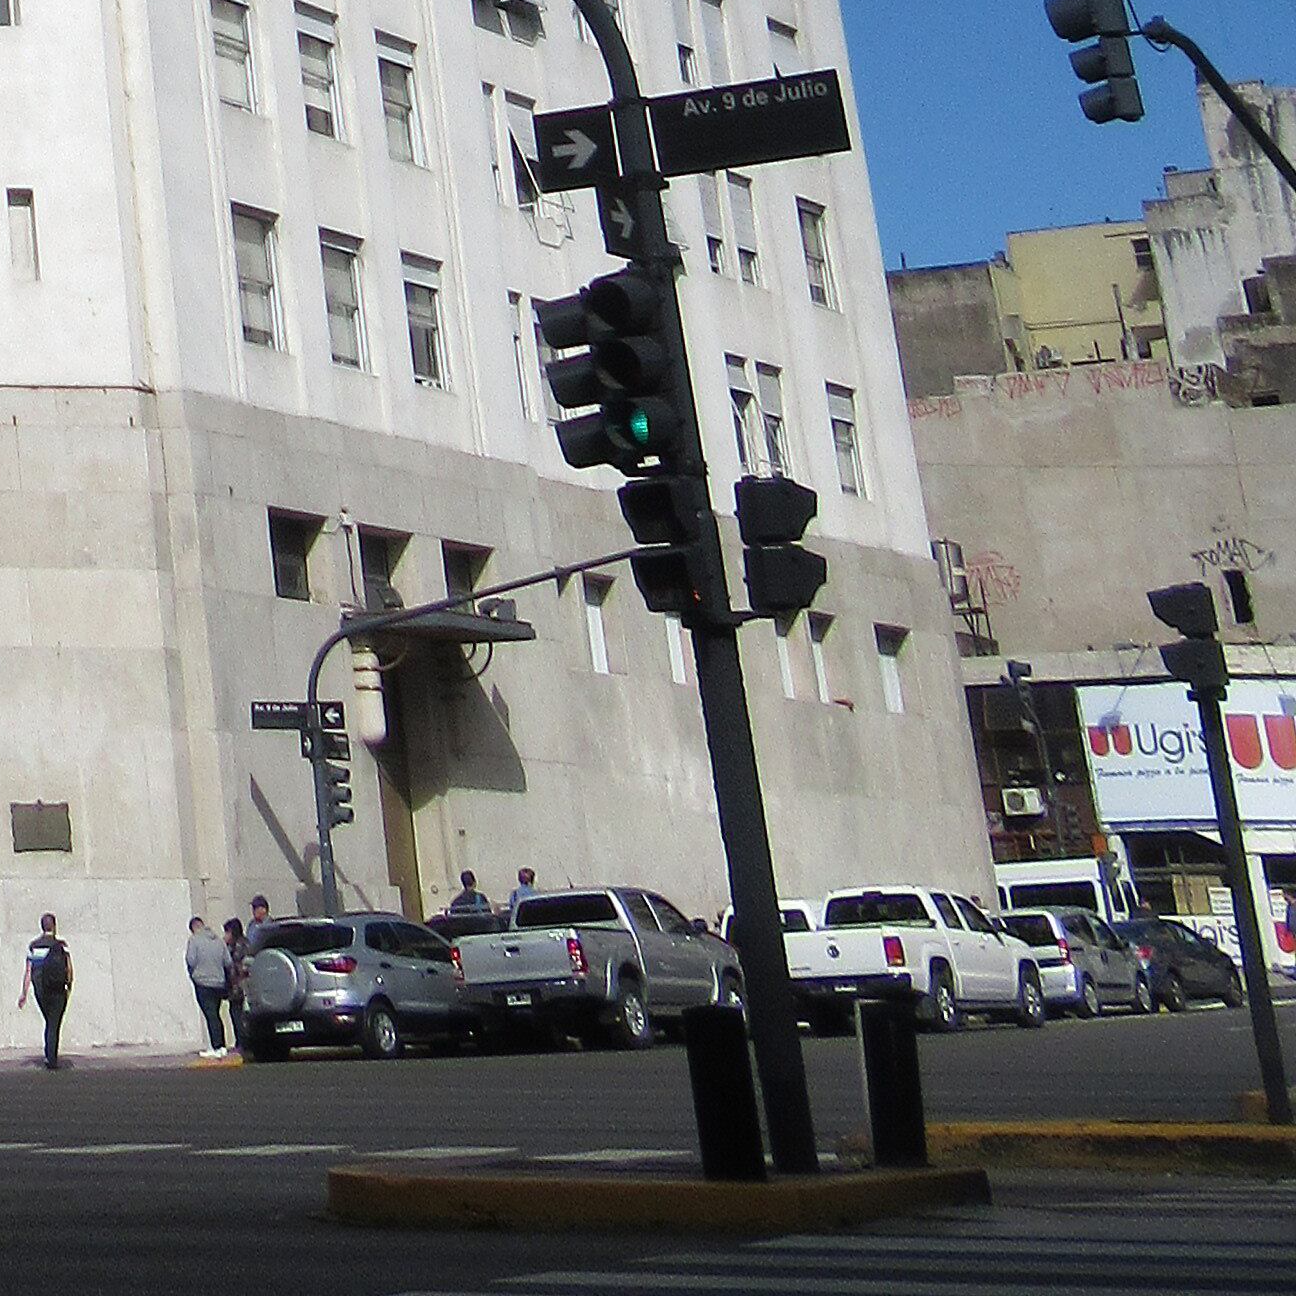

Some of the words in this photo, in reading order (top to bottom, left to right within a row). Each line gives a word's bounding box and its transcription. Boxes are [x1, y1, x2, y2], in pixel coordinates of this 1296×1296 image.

[682, 97, 718, 117] Av.
[721, 91, 737, 111] 9
[742, 88, 769, 107] de
[774, 79, 828, 103] Julio
